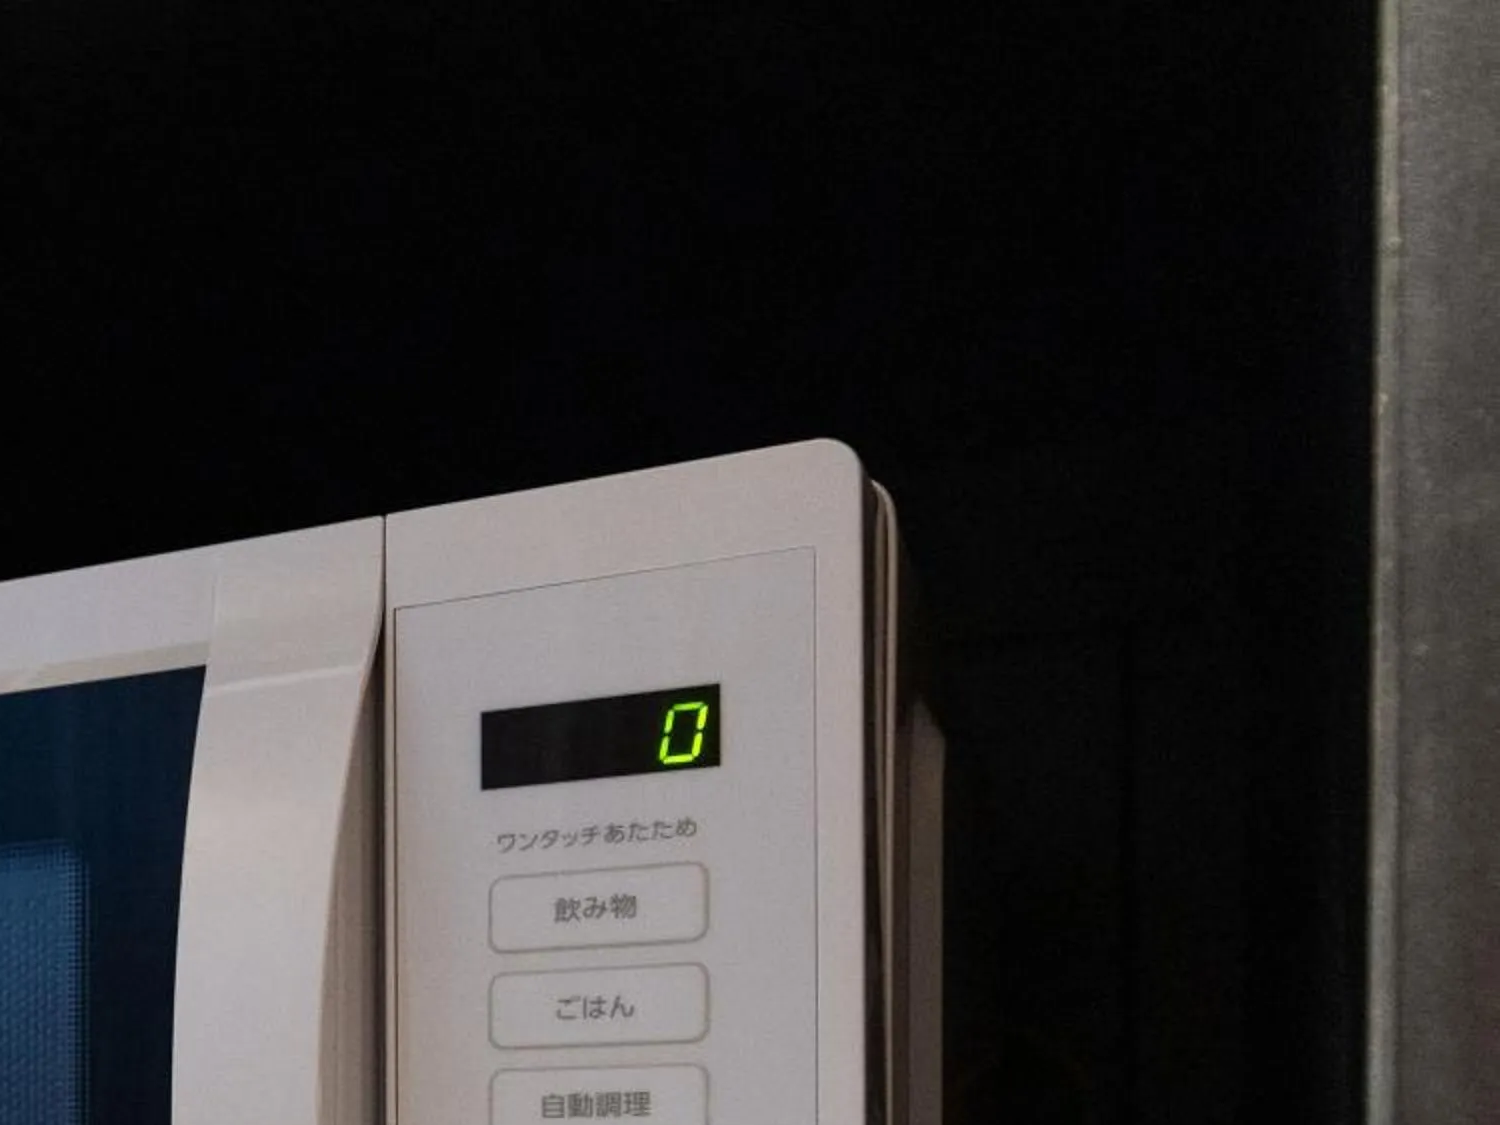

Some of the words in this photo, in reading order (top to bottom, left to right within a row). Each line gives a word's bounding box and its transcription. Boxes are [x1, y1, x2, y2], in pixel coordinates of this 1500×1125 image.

[658, 701, 710, 765] 0
[496, 816, 698, 854] ワンタッチあたため
[553, 893, 638, 924] 飲み物
[555, 994, 636, 1021] ごはん
[541, 1091, 652, 1119] 自動調理
